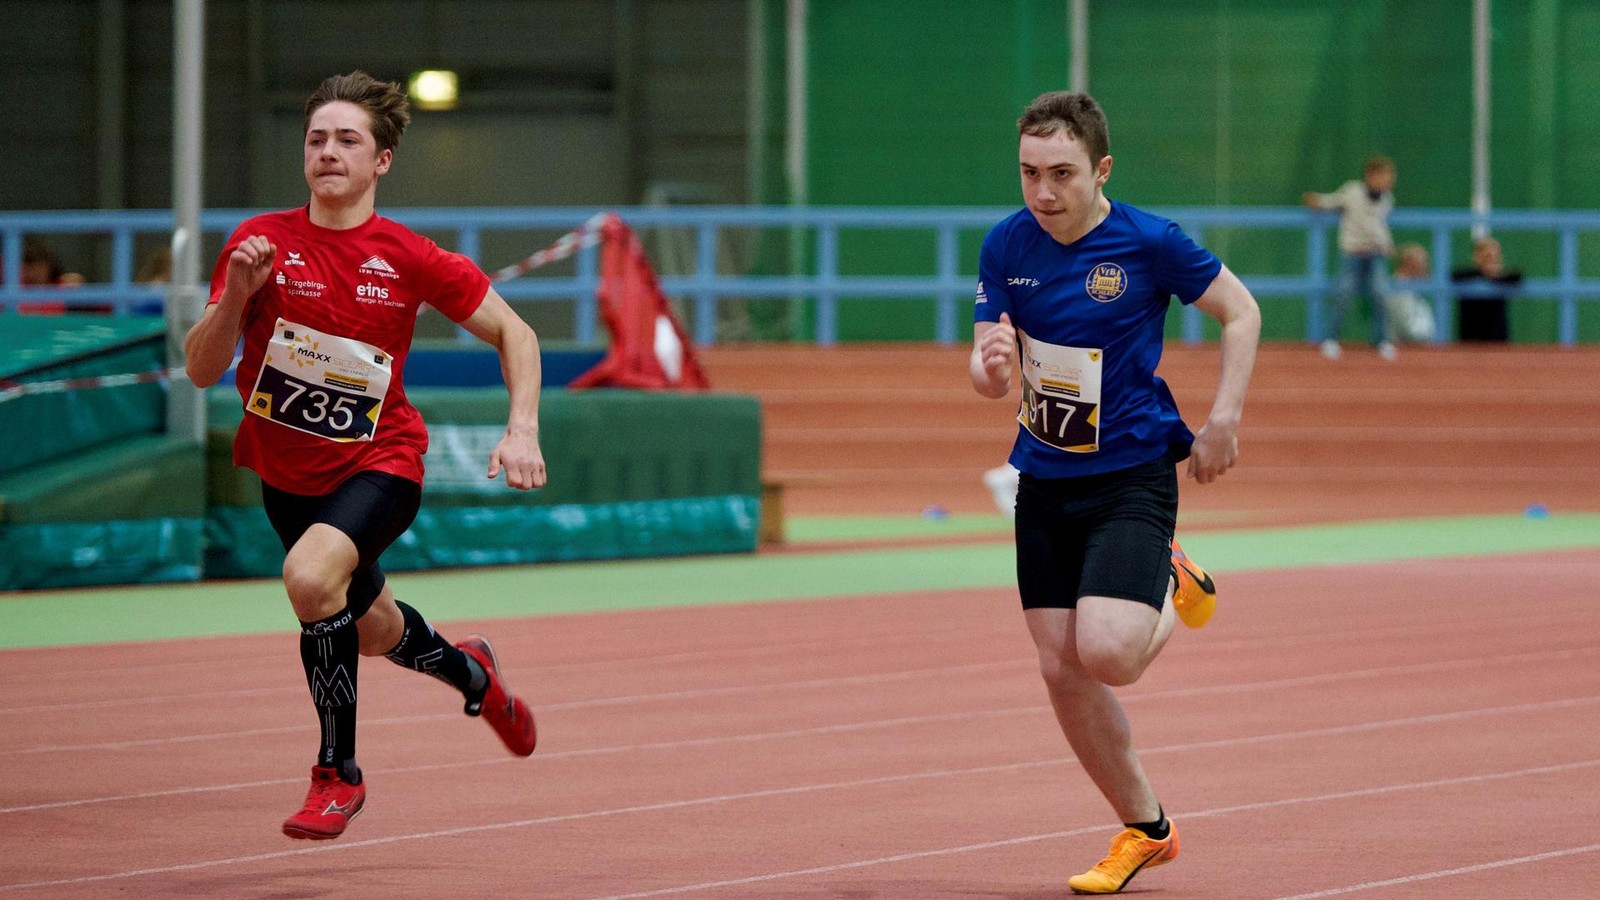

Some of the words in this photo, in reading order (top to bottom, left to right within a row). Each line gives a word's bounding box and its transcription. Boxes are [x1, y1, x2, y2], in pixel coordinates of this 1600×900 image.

[1101, 266, 1117, 276] VfB
[288, 279, 327, 290] Erzgebirgs-
[357, 282, 389, 299] eins
[288, 288, 321, 298] sparkasse
[356, 296, 377, 305] energie
[384, 300, 405, 308] sachsen
[298, 347, 331, 363] MAXX
[280, 379, 358, 430] 735
[1029, 388, 1076, 438] 917
